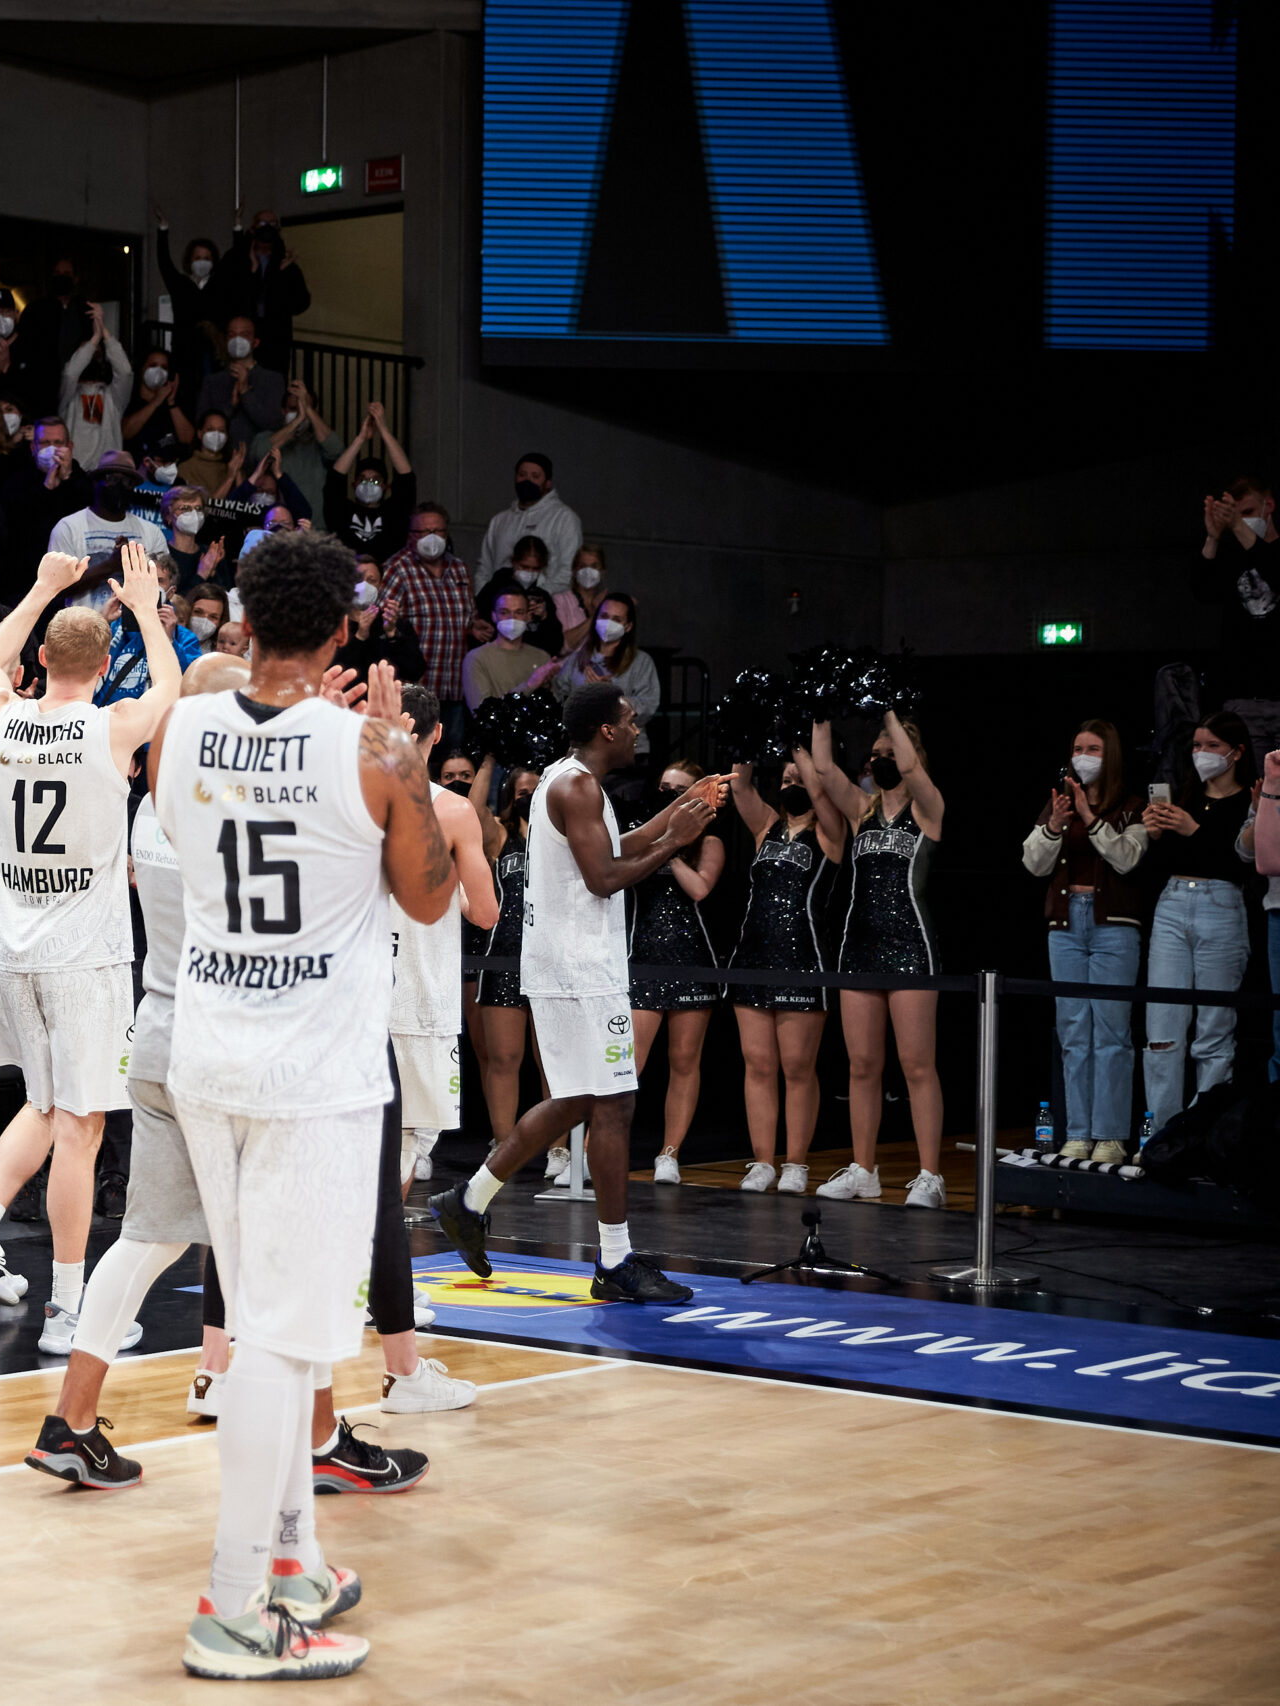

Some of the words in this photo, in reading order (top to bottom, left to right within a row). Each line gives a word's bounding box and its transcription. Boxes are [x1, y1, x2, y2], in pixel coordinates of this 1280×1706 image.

[4, 718, 86, 745] HINRICHS
[38, 752, 83, 765] BLACK
[198, 730, 311, 772] BLUIETT
[253, 786, 318, 803] BLACK
[11, 779, 67, 855] 12
[136, 849, 154, 861] ENDO
[1, 862, 94, 894] HAMBURG
[217, 818, 302, 934] 15
[789, 995, 816, 1003] KEBAB
